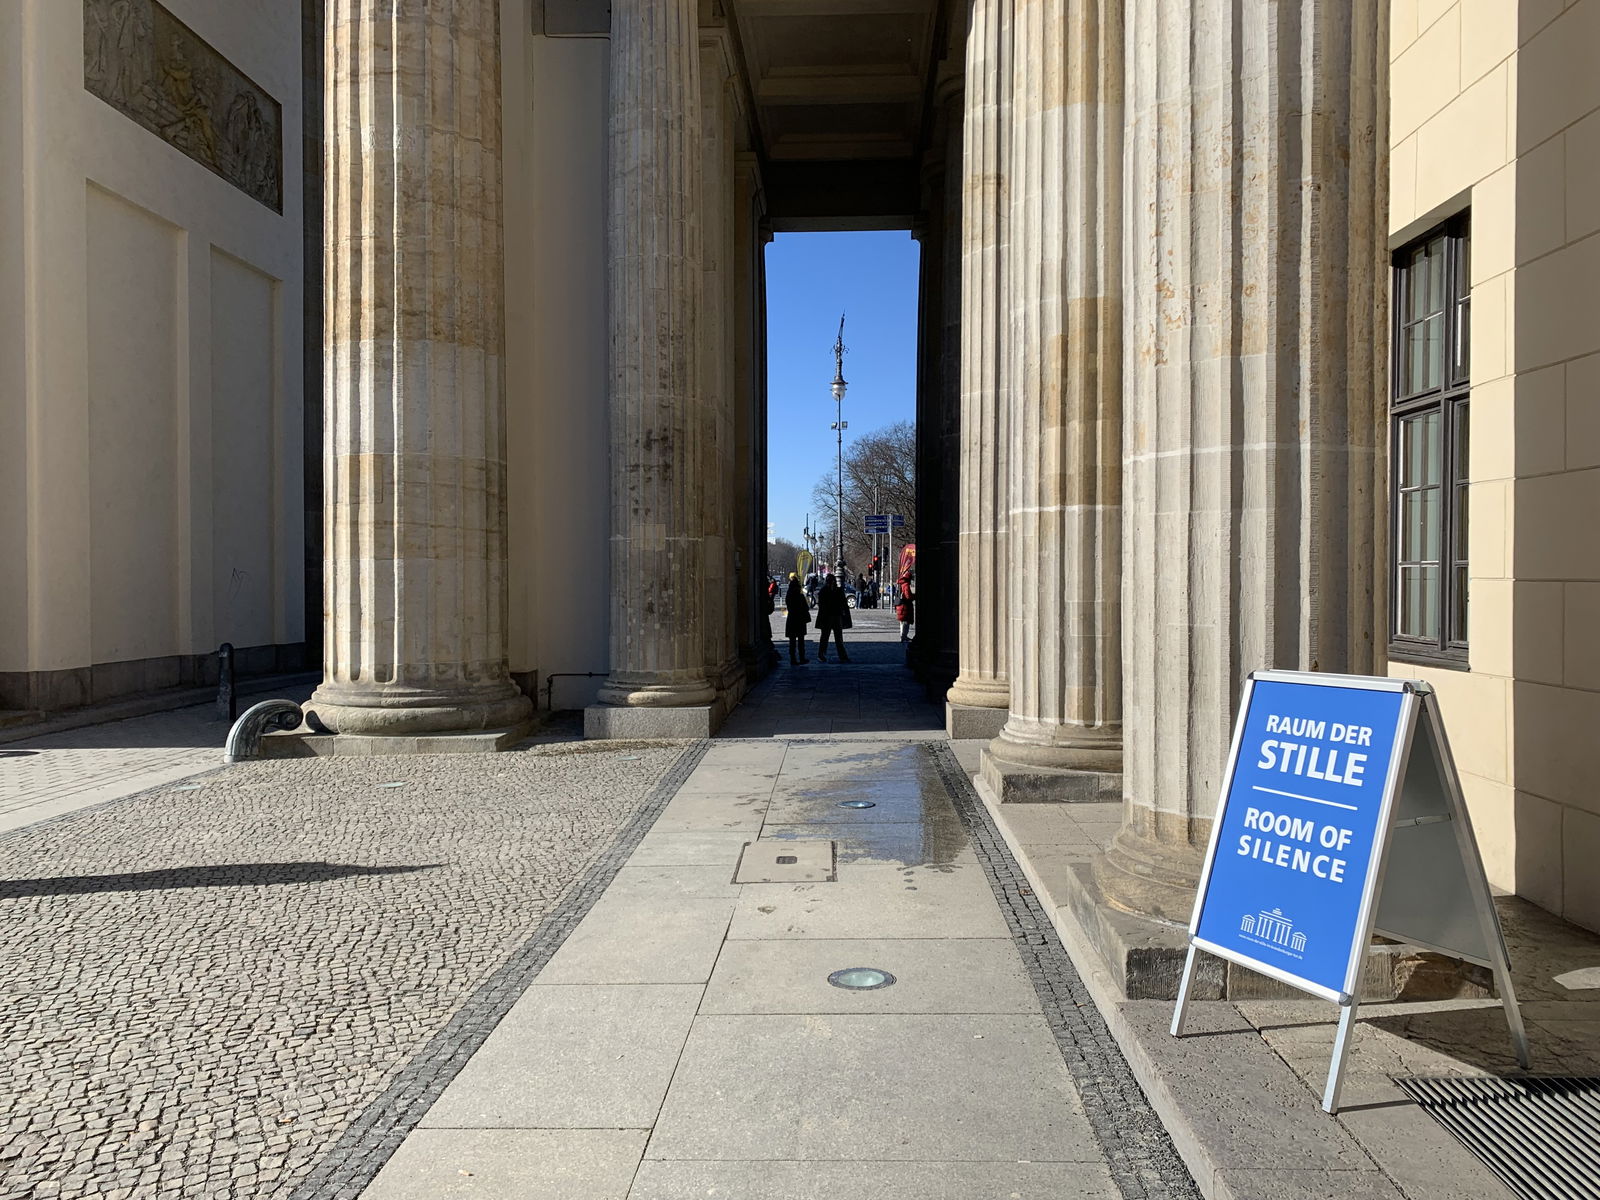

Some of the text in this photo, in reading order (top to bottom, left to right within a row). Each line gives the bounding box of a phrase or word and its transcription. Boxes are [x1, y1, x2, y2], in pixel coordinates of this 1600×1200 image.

[1266, 715, 1373, 747] RAUM DER
[1257, 740, 1368, 787] STILLE
[1244, 808, 1353, 851] ROOM OF
[1237, 835, 1347, 882] SILENCE
